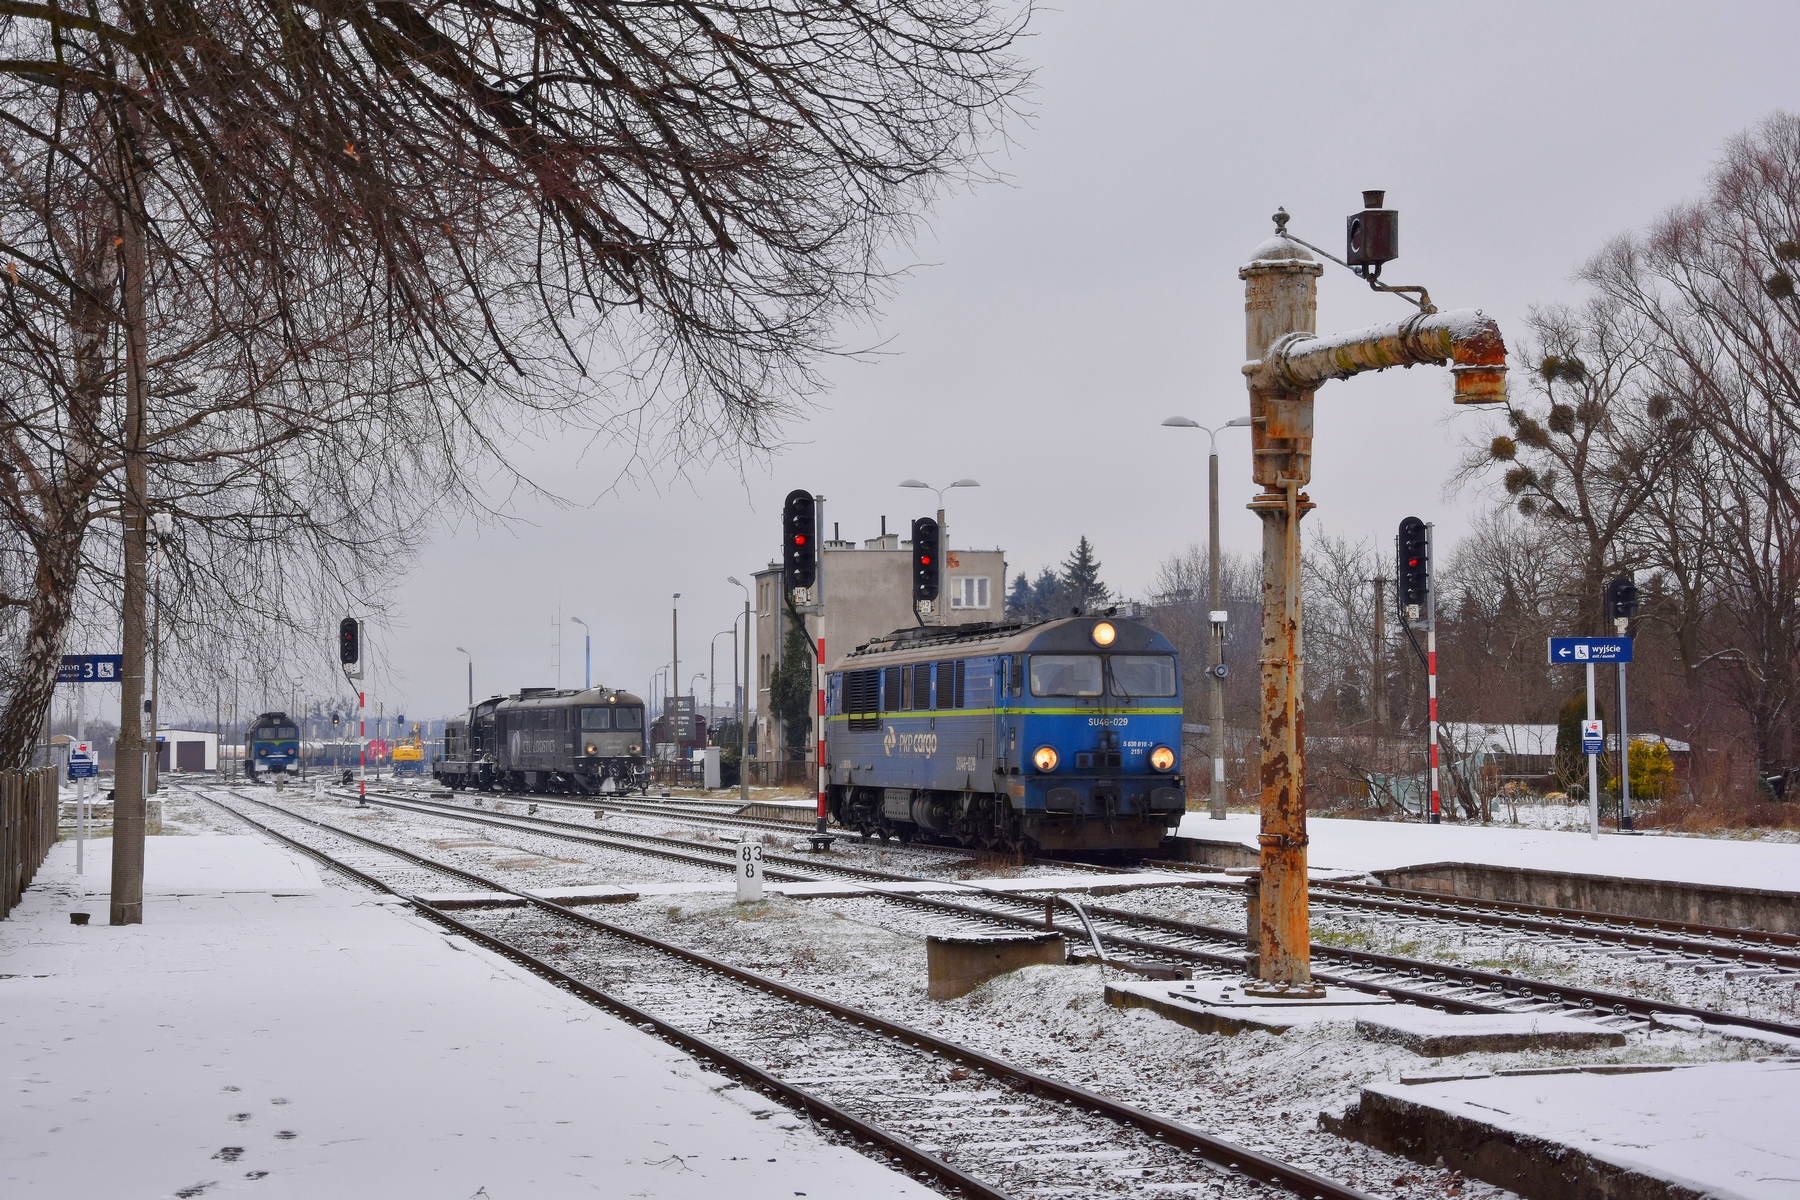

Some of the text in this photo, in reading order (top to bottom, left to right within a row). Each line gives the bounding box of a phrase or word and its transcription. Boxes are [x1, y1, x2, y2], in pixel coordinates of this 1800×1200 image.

[1591, 644, 1621, 655] wyjście
[83, 662, 94, 679] 3
[1088, 717, 1129, 726] SU46-029
[899, 733, 938, 759] PKP cargo
[742, 846, 762, 861] 83
[745, 863, 755, 878] 8
